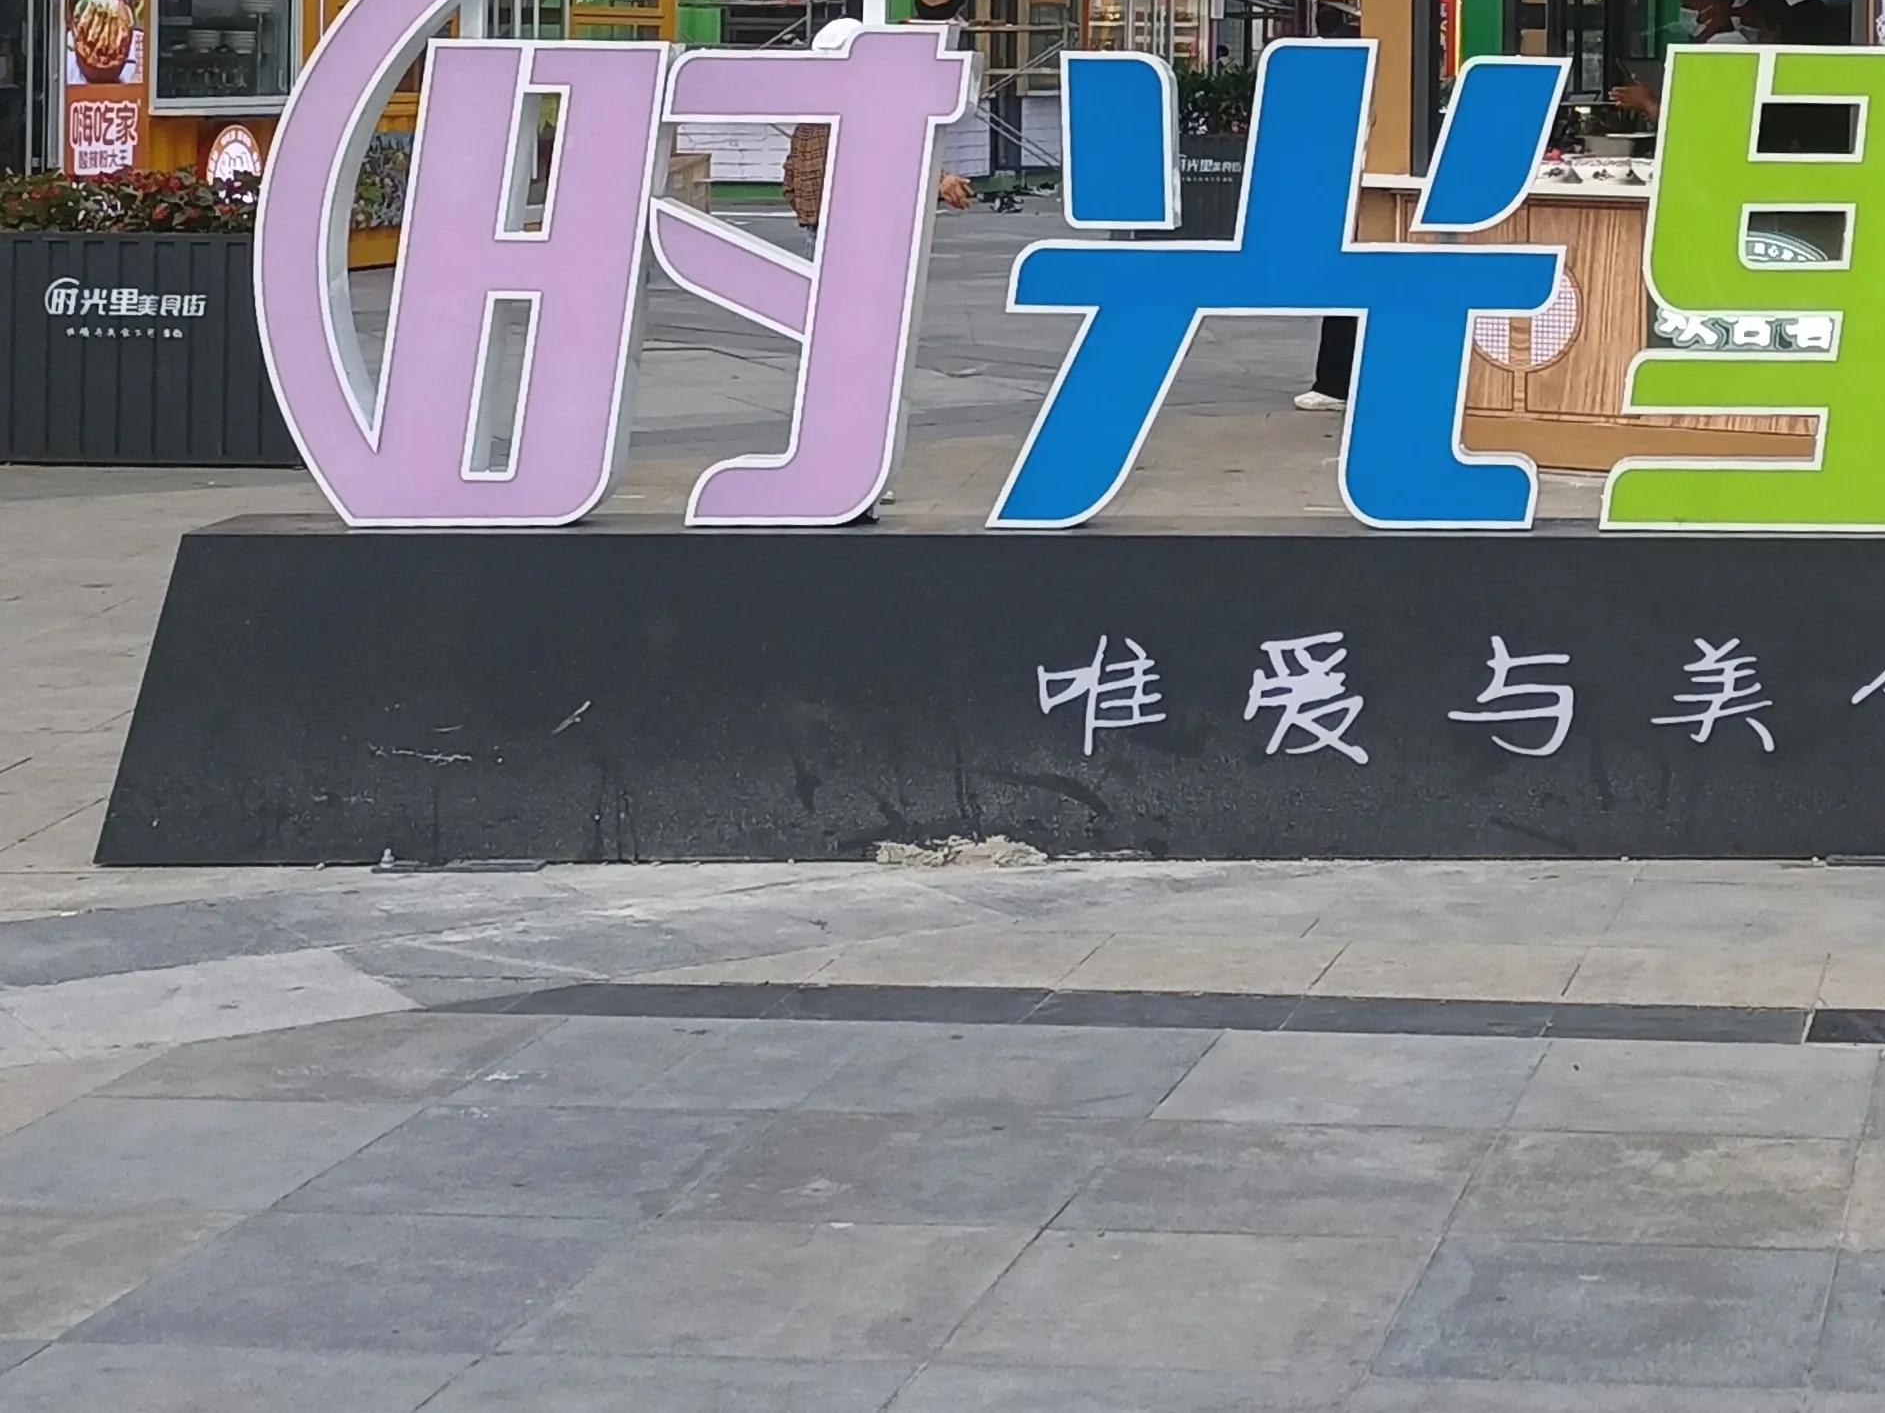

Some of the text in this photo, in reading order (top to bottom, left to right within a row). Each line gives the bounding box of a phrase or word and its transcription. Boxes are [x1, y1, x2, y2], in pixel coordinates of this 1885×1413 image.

[72, 104, 137, 146] 嗨吃家
[44, 277, 207, 317] 时光里美食街
